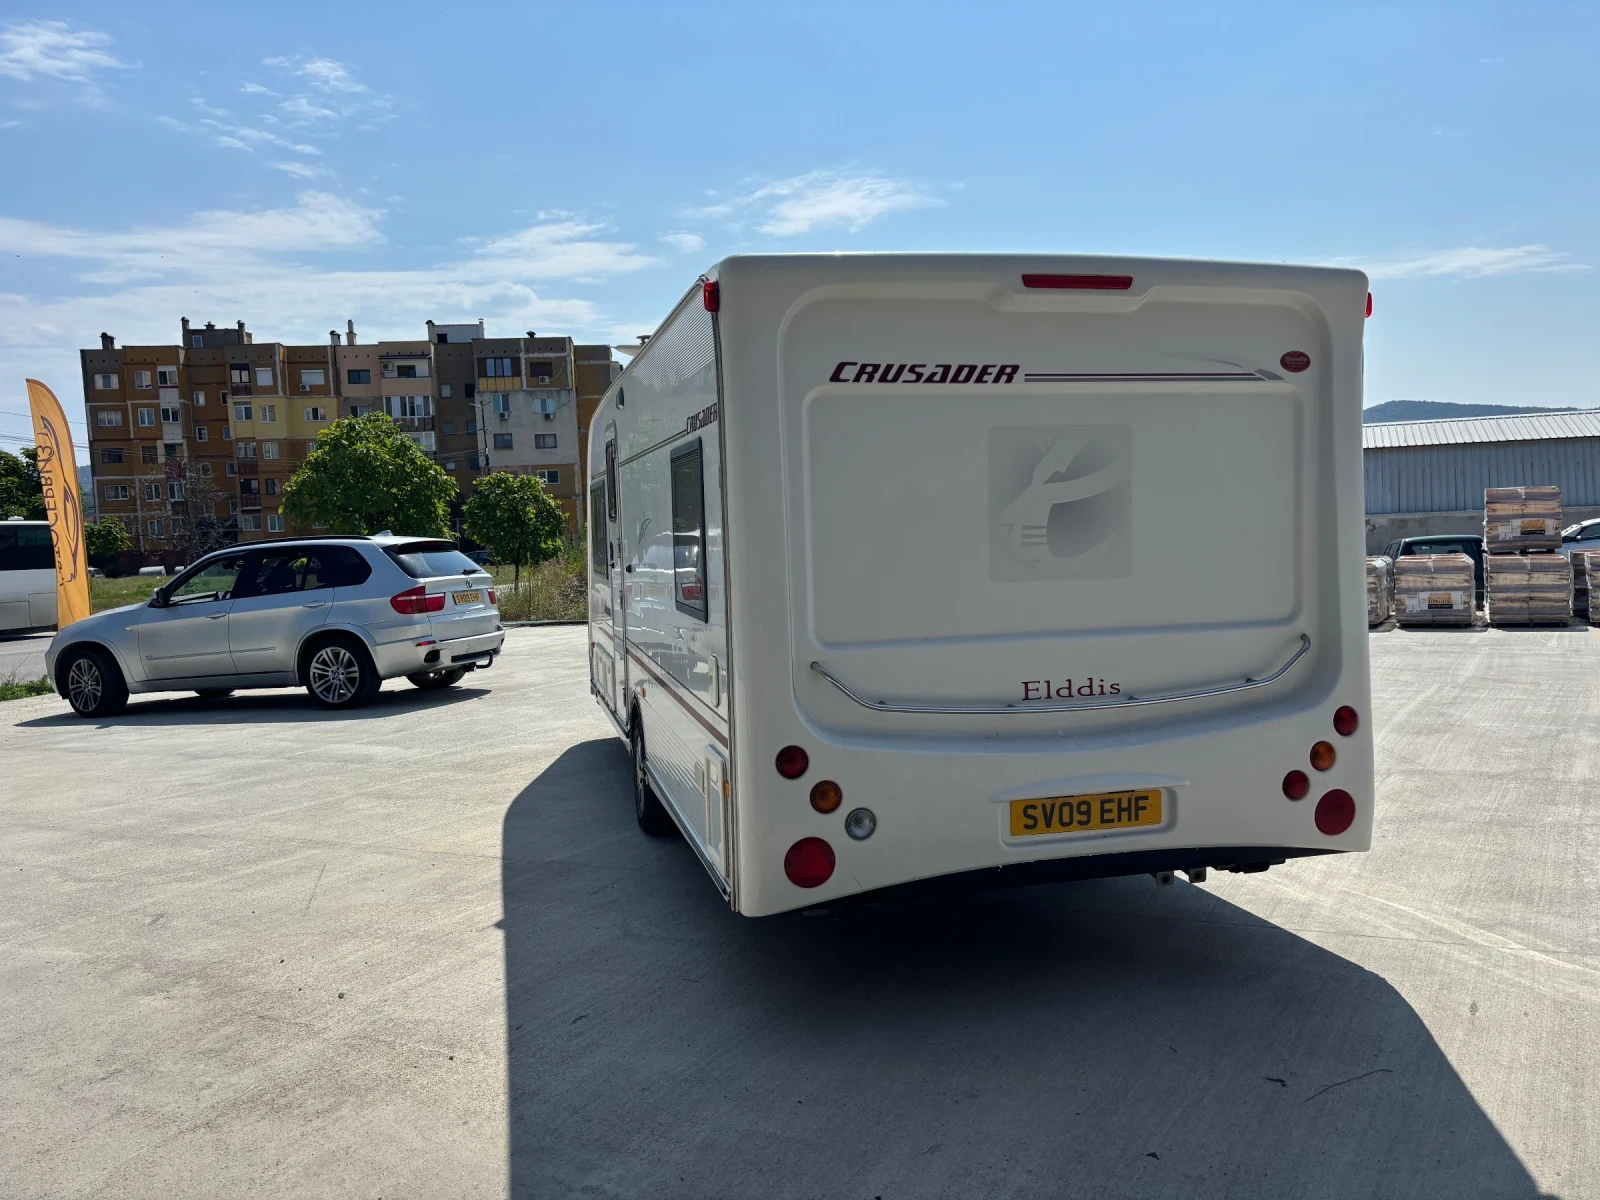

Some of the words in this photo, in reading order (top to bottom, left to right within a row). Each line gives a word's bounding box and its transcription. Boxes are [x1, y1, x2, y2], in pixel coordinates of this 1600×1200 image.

[829, 362, 1020, 384] CRUSADER
[686, 401, 718, 435] CRUSADER
[1021, 677, 1121, 701] Elddis
[1022, 800, 1092, 830] SV09
[1100, 795, 1149, 824] EHF
